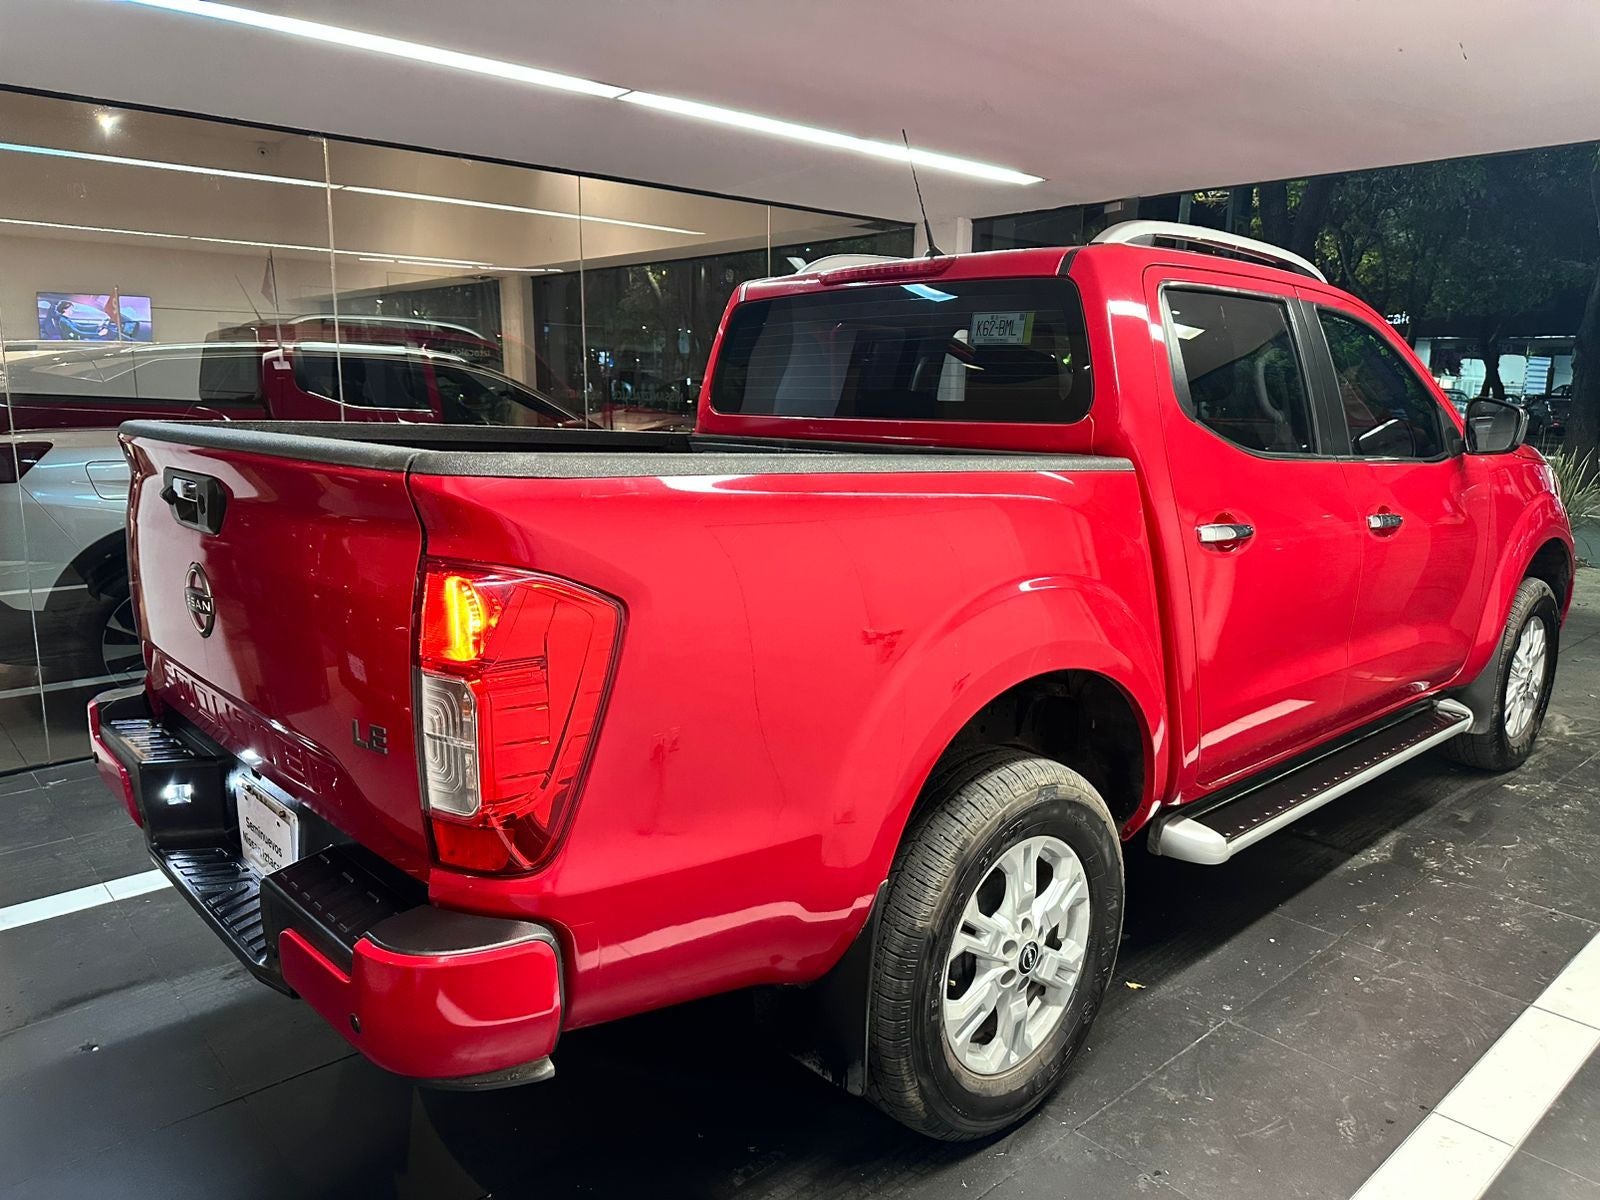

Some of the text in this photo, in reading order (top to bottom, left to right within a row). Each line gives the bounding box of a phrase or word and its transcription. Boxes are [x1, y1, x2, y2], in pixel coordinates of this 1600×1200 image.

[976, 319, 1017, 337] K62-BML
[351, 718, 388, 756] LE
[245, 816, 283, 858] Seminuevos
